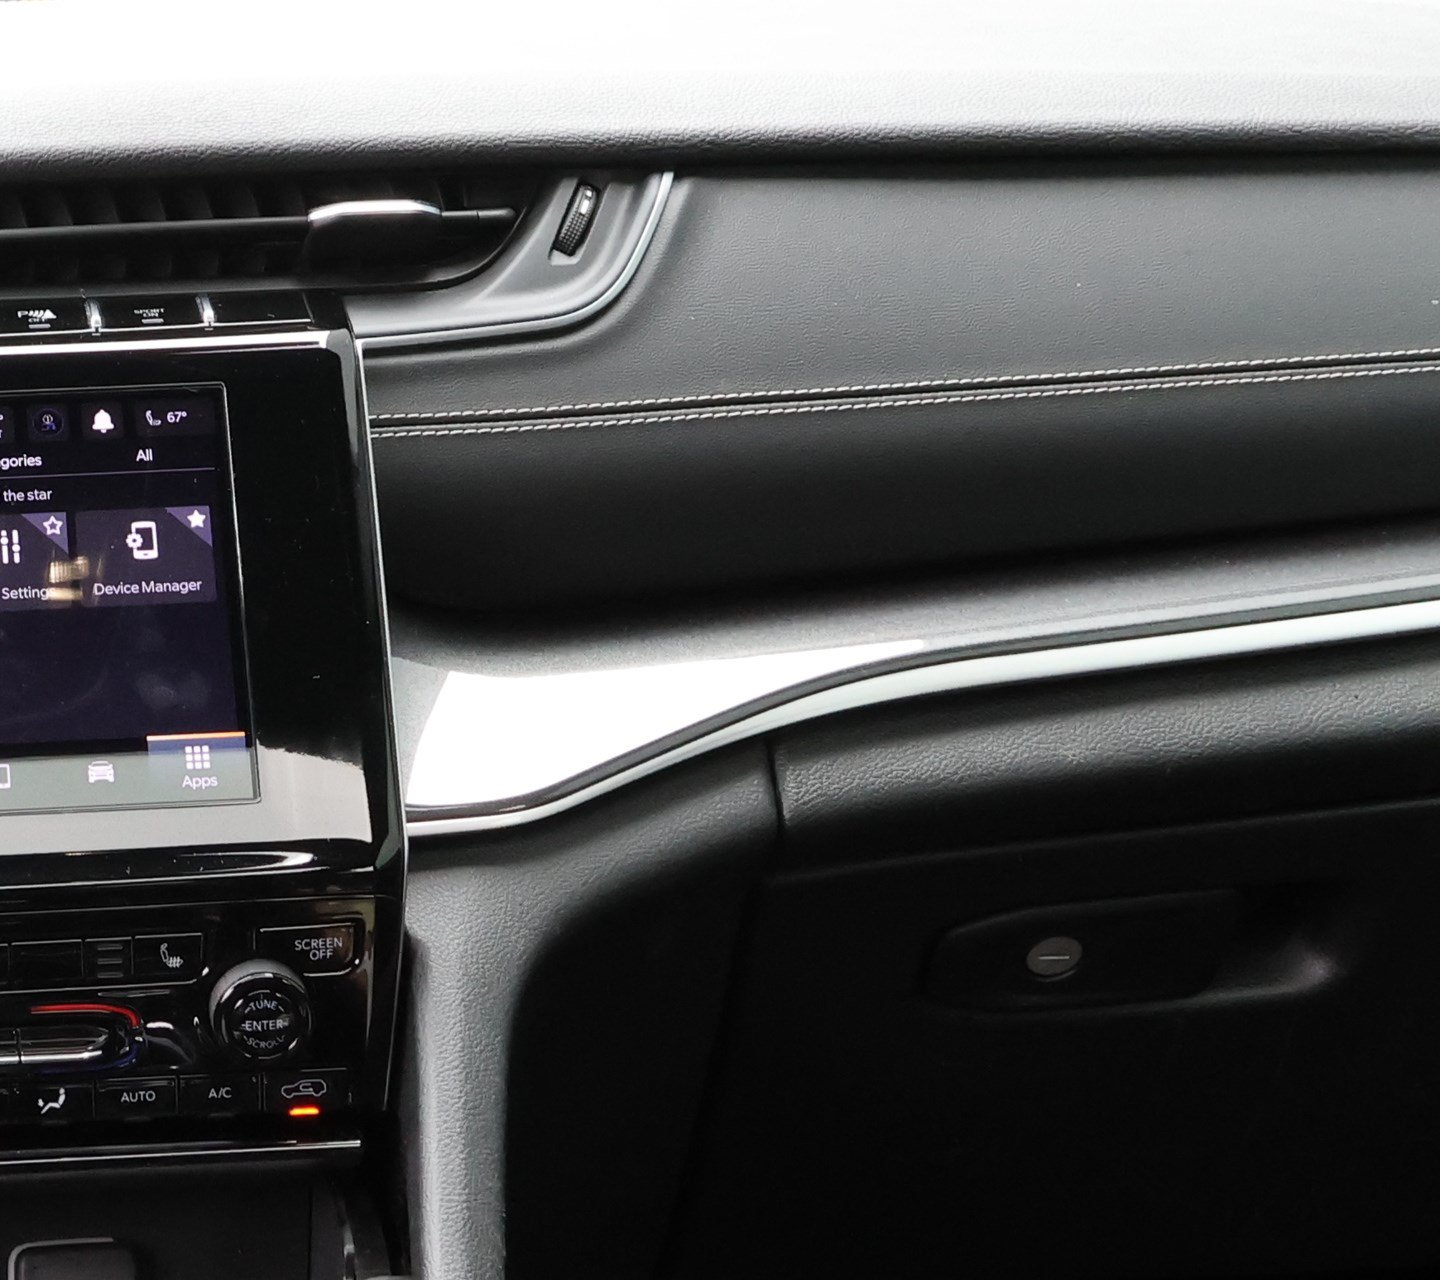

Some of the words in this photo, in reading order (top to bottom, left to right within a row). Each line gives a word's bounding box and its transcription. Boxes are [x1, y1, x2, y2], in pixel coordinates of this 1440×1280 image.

[135, 448, 153, 462] All
[2, 488, 25, 503] the
[27, 488, 53, 501] star
[93, 582, 139, 596] Device
[141, 579, 203, 596] Manager
[182, 774, 218, 790] Apps
[293, 937, 343, 952] SCREEN
[309, 948, 334, 961] OFF
[249, 999, 278, 1011] TUNE
[245, 1019, 283, 1032] ENTER
[120, 1090, 156, 1103] AUTO
[208, 1086, 232, 1100] A/C
